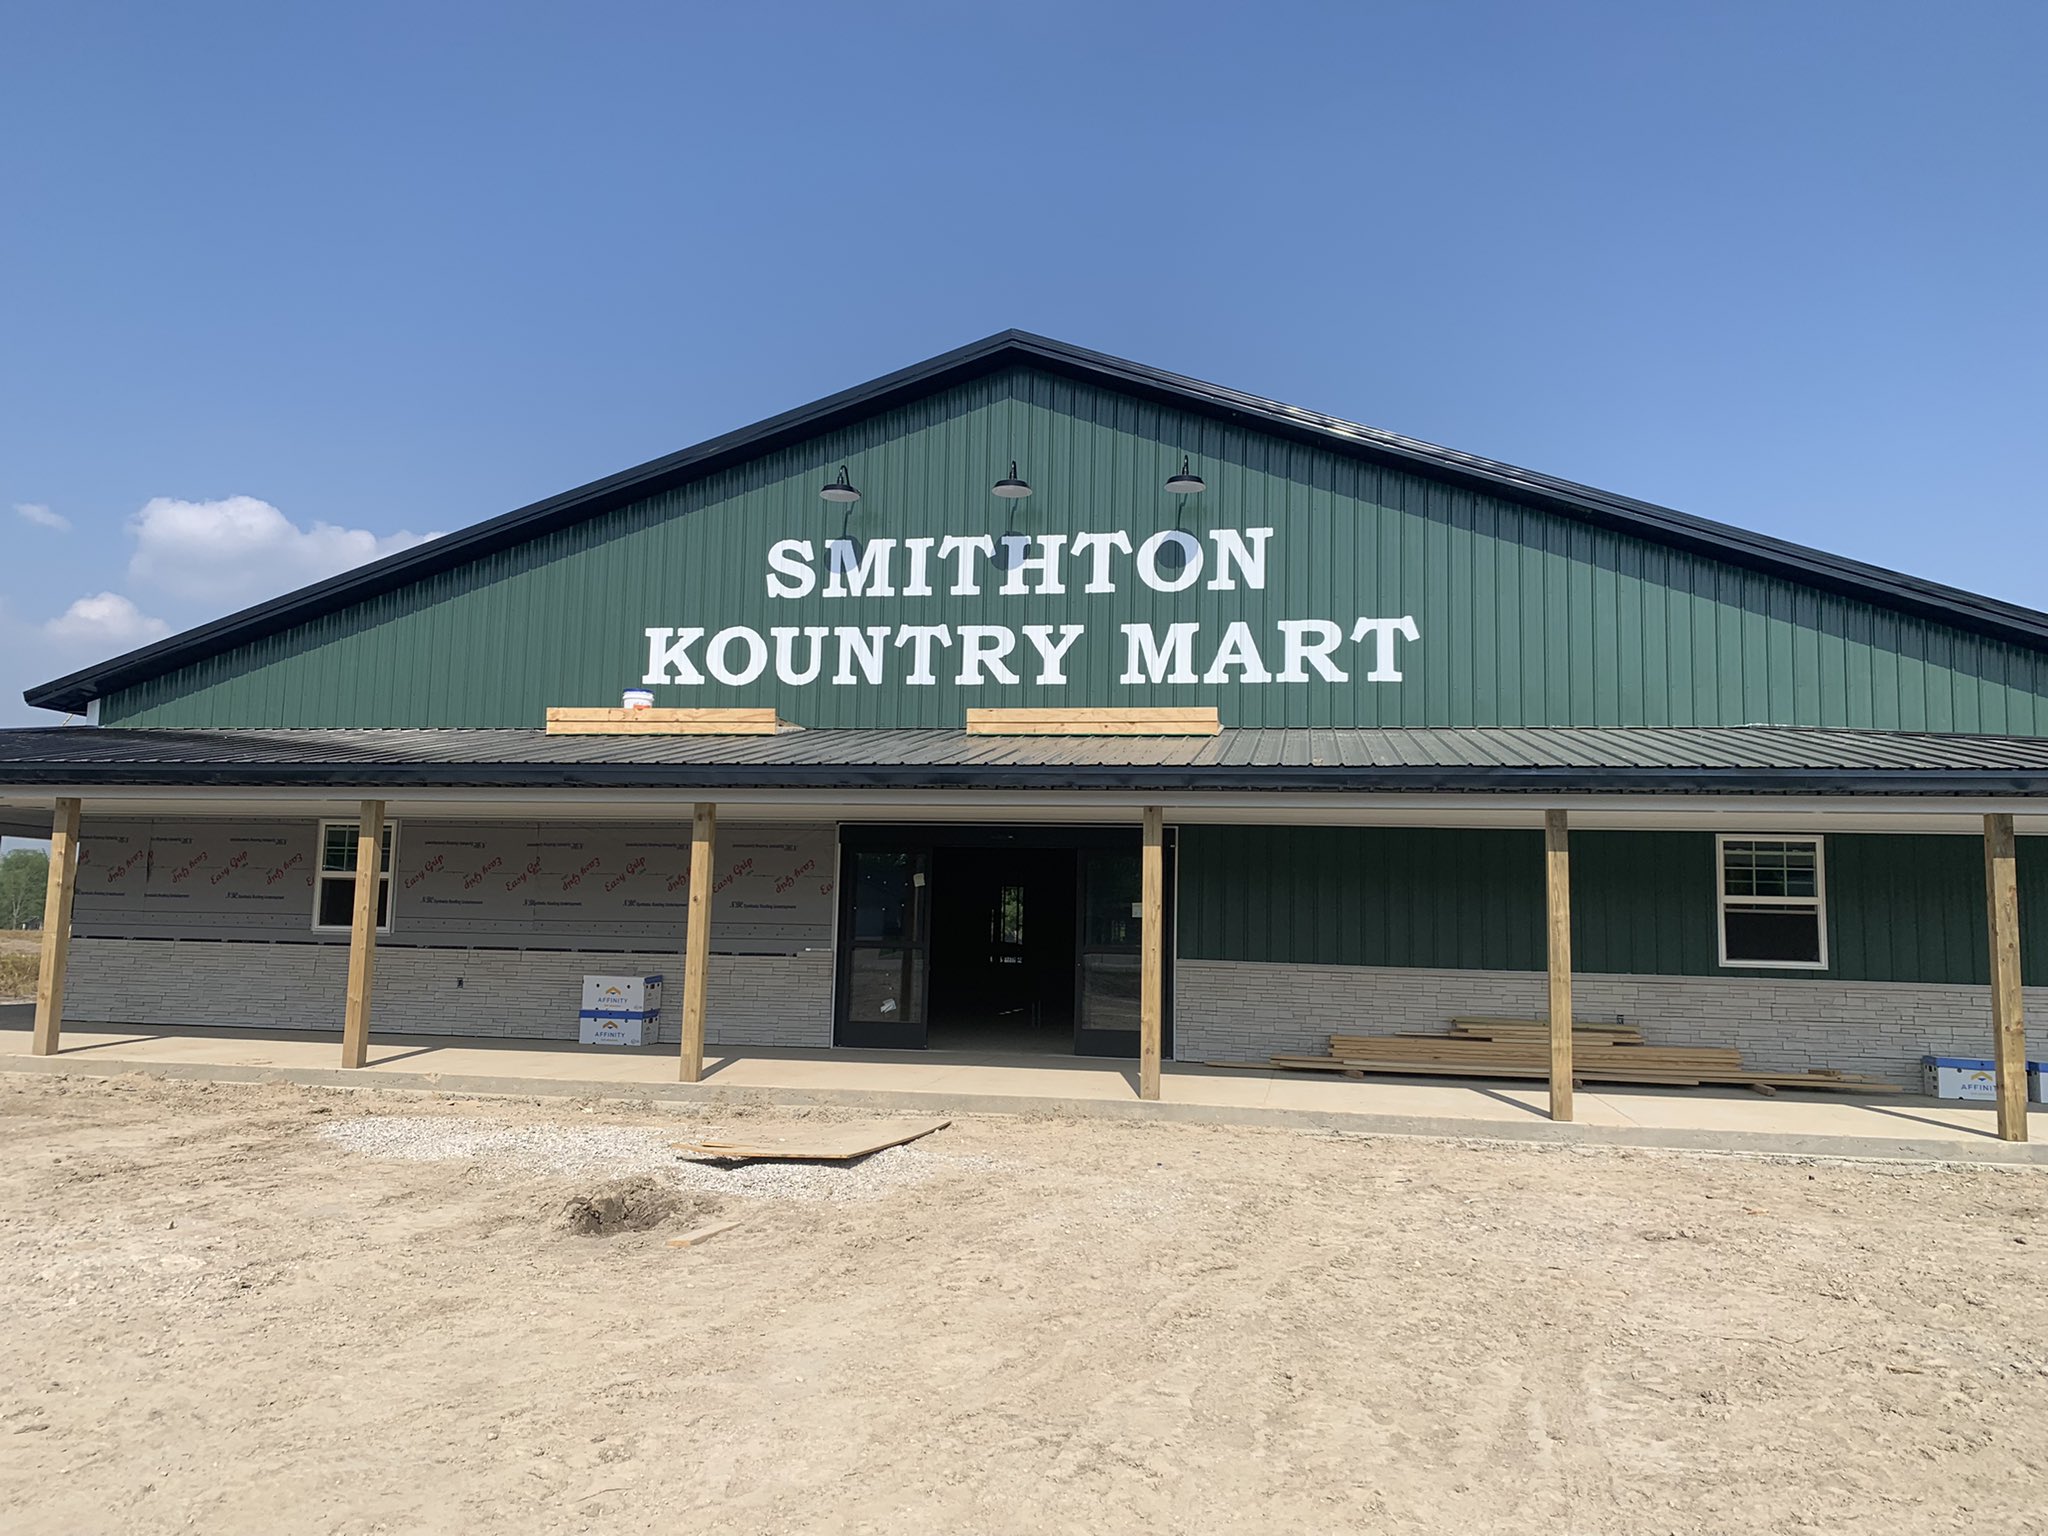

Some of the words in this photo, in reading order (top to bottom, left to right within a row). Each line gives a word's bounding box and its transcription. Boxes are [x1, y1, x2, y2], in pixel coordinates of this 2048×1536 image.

[766, 527, 1274, 599] SMITHTON
[641, 623, 1085, 686] KOUNTRY
[1119, 615, 1420, 685] MART
